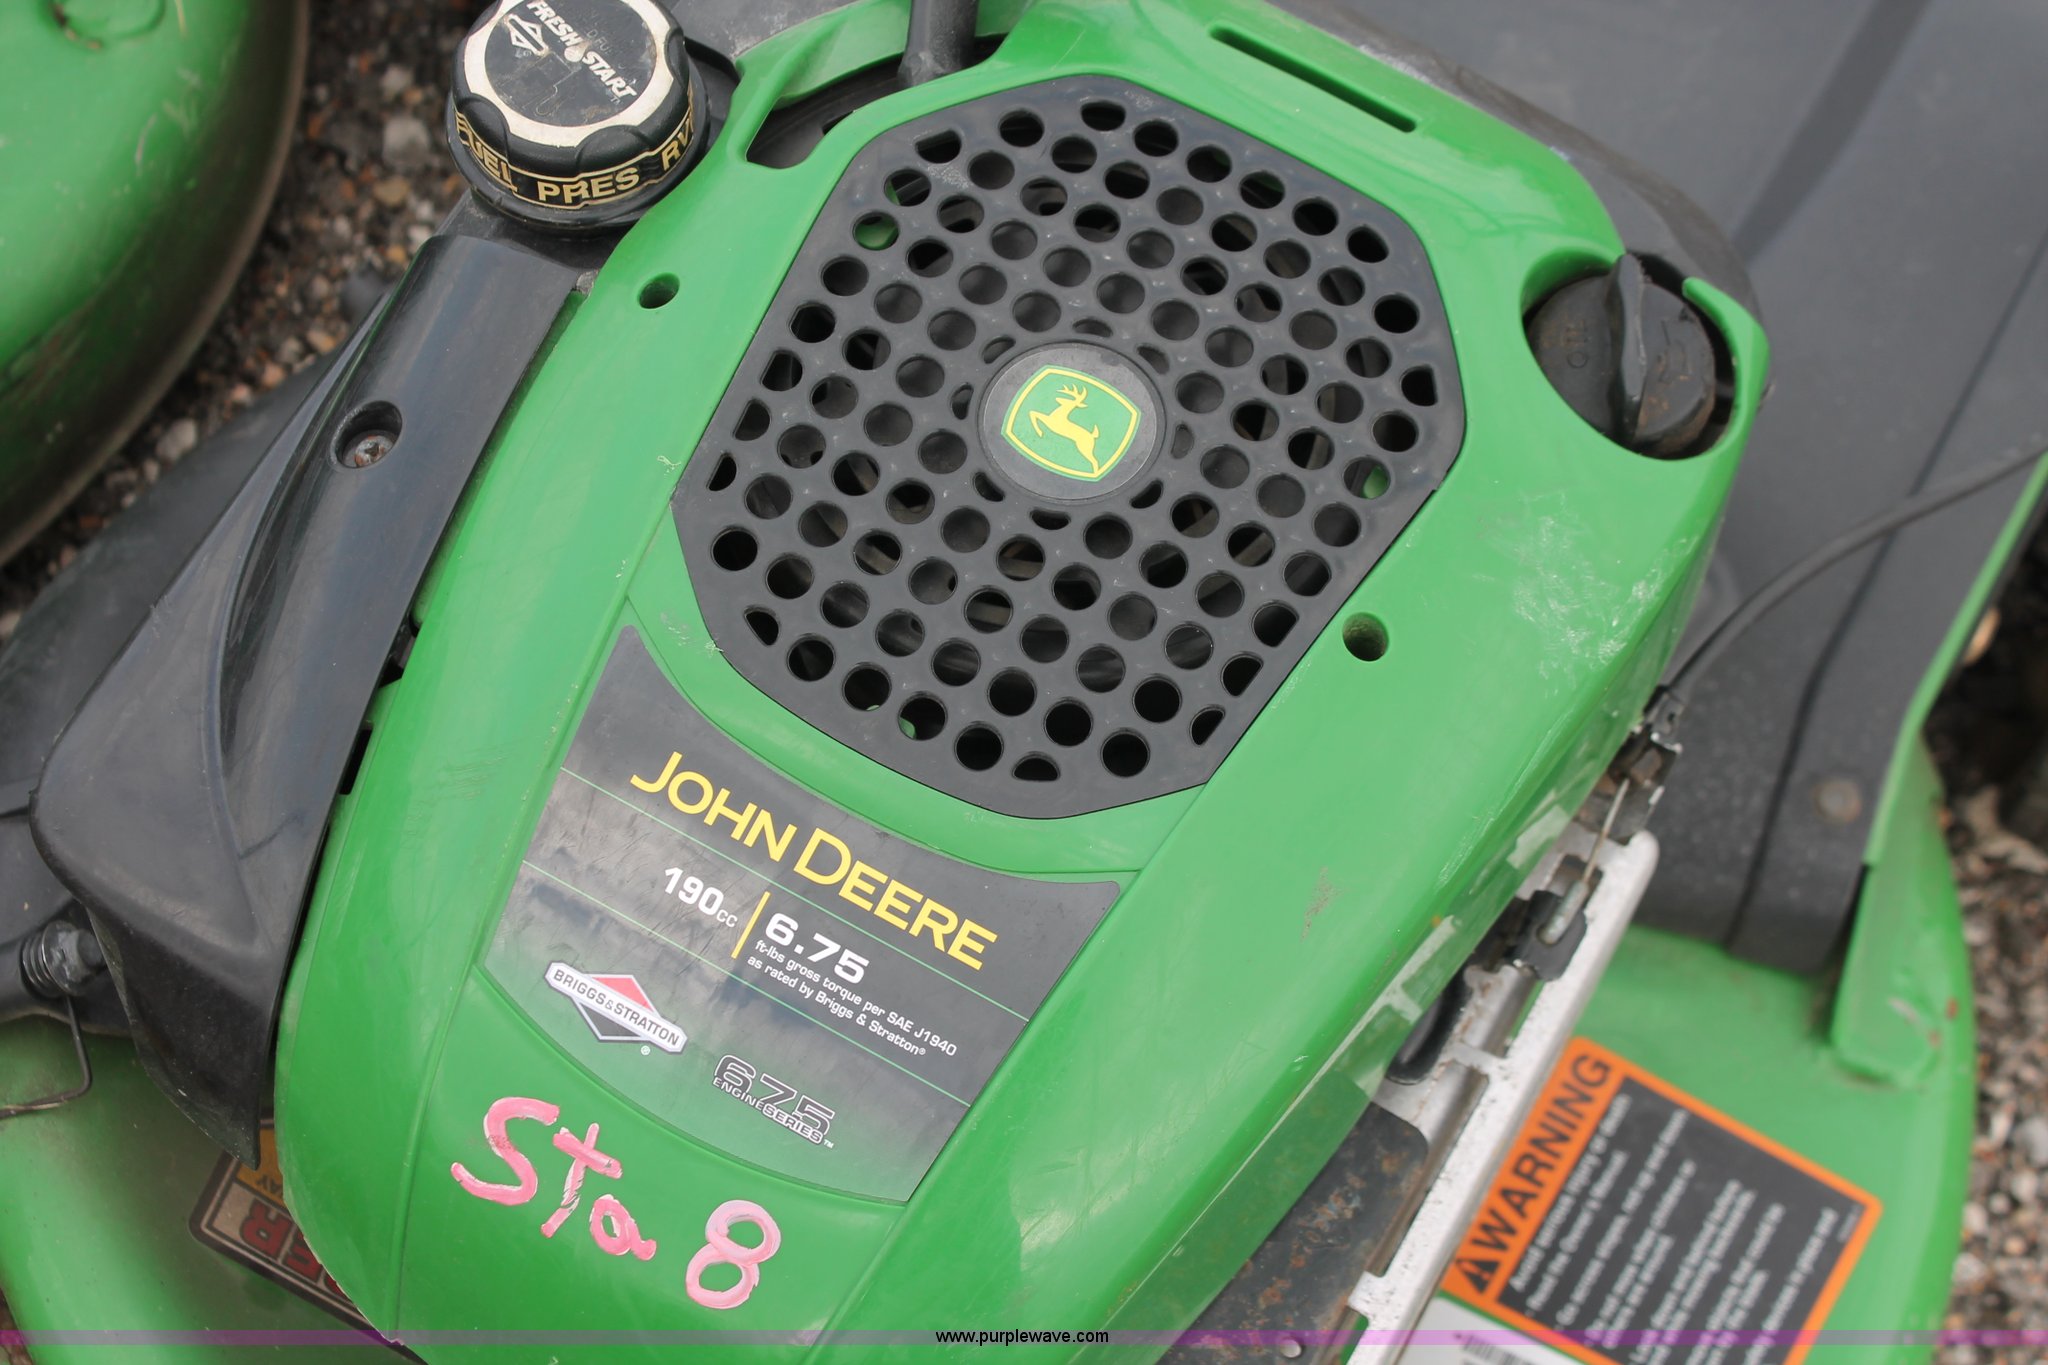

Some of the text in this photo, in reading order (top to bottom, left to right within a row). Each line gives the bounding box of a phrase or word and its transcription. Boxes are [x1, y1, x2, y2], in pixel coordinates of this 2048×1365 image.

[526, 0, 583, 46] FRESH
[582, 51, 637, 98] START
[630, 751, 998, 970] JOHN DEERE
[664, 867, 737, 928] 190cc
[748, 956, 762, 970] as
[764, 965, 798, 988] rated
[799, 982, 814, 998] by
[815, 991, 854, 1019] Briggs
[856, 1014, 866, 1026] &
[766, 913, 869, 983] 6.75
[755, 940, 957, 1056] ft-lbs gross torque per SAE J1940
[714, 1055, 836, 1135] 675
[1474, 1054, 1612, 1259] WARNING
[685, 1199, 781, 1309] 8
